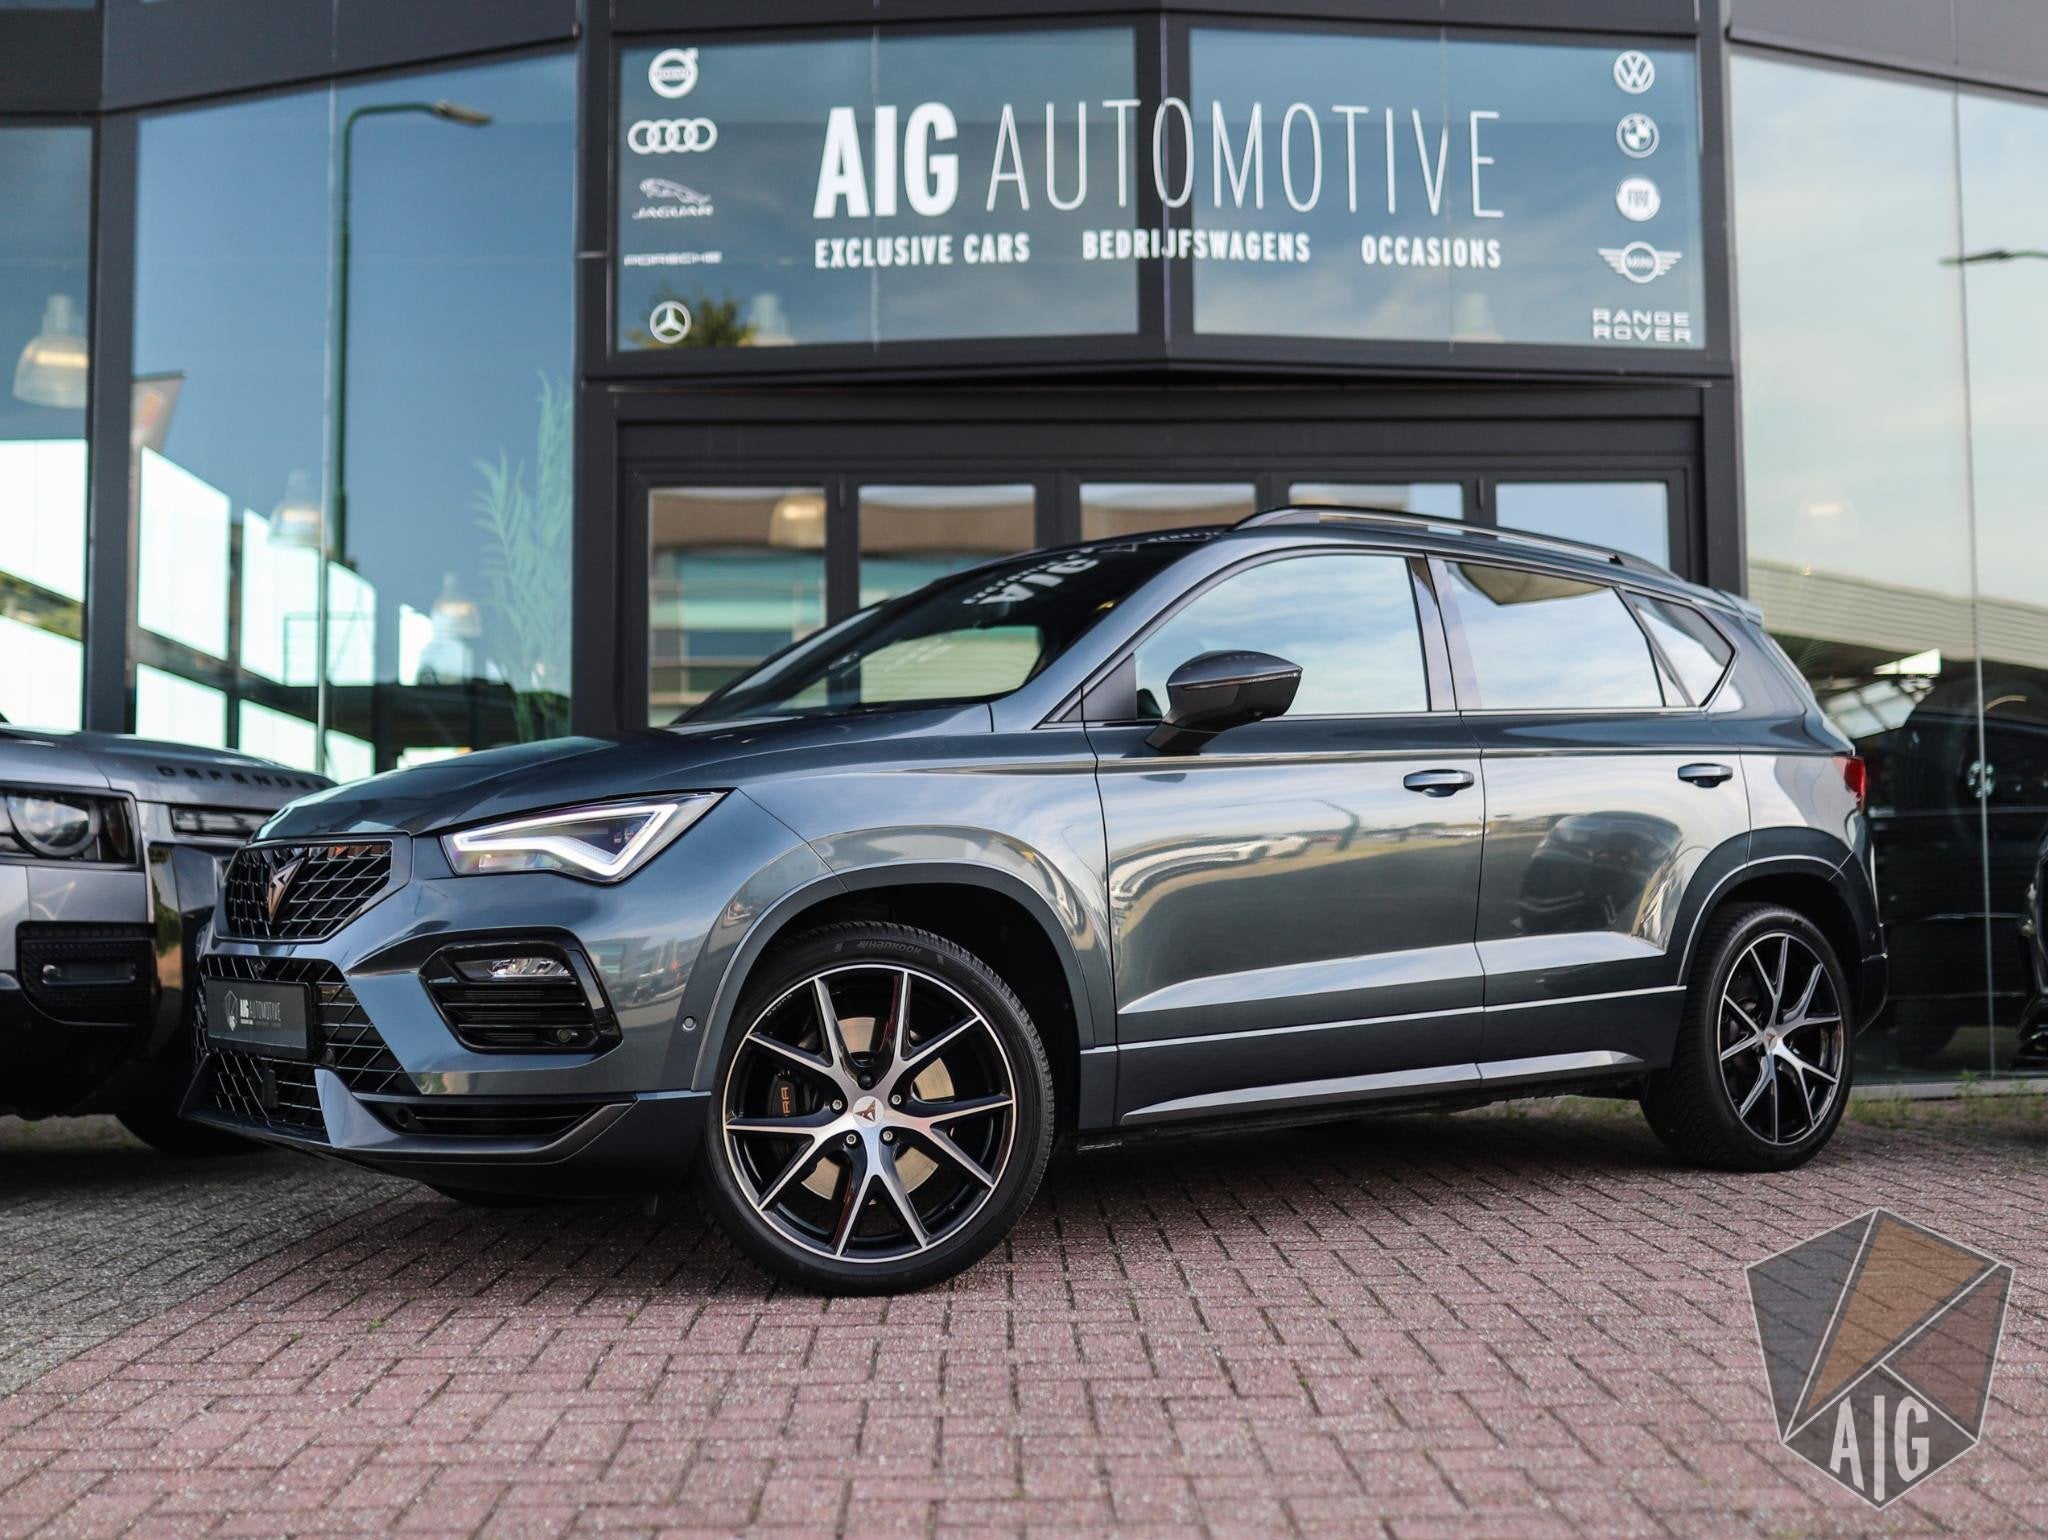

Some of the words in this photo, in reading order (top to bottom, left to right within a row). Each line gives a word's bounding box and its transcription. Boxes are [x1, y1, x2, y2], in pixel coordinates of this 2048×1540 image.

[813, 102, 959, 218] AIG
[986, 97, 1505, 219] AUTOMOTIVE
[815, 235, 953, 269] EXCLUSIVE
[963, 233, 1030, 264] CARS
[1082, 229, 1311, 263] BEDRIJFSWAGENS
[1360, 235, 1502, 269] OCCASIONS
[1592, 308, 1690, 326] RANGE
[1593, 324, 1692, 343] ROVER
